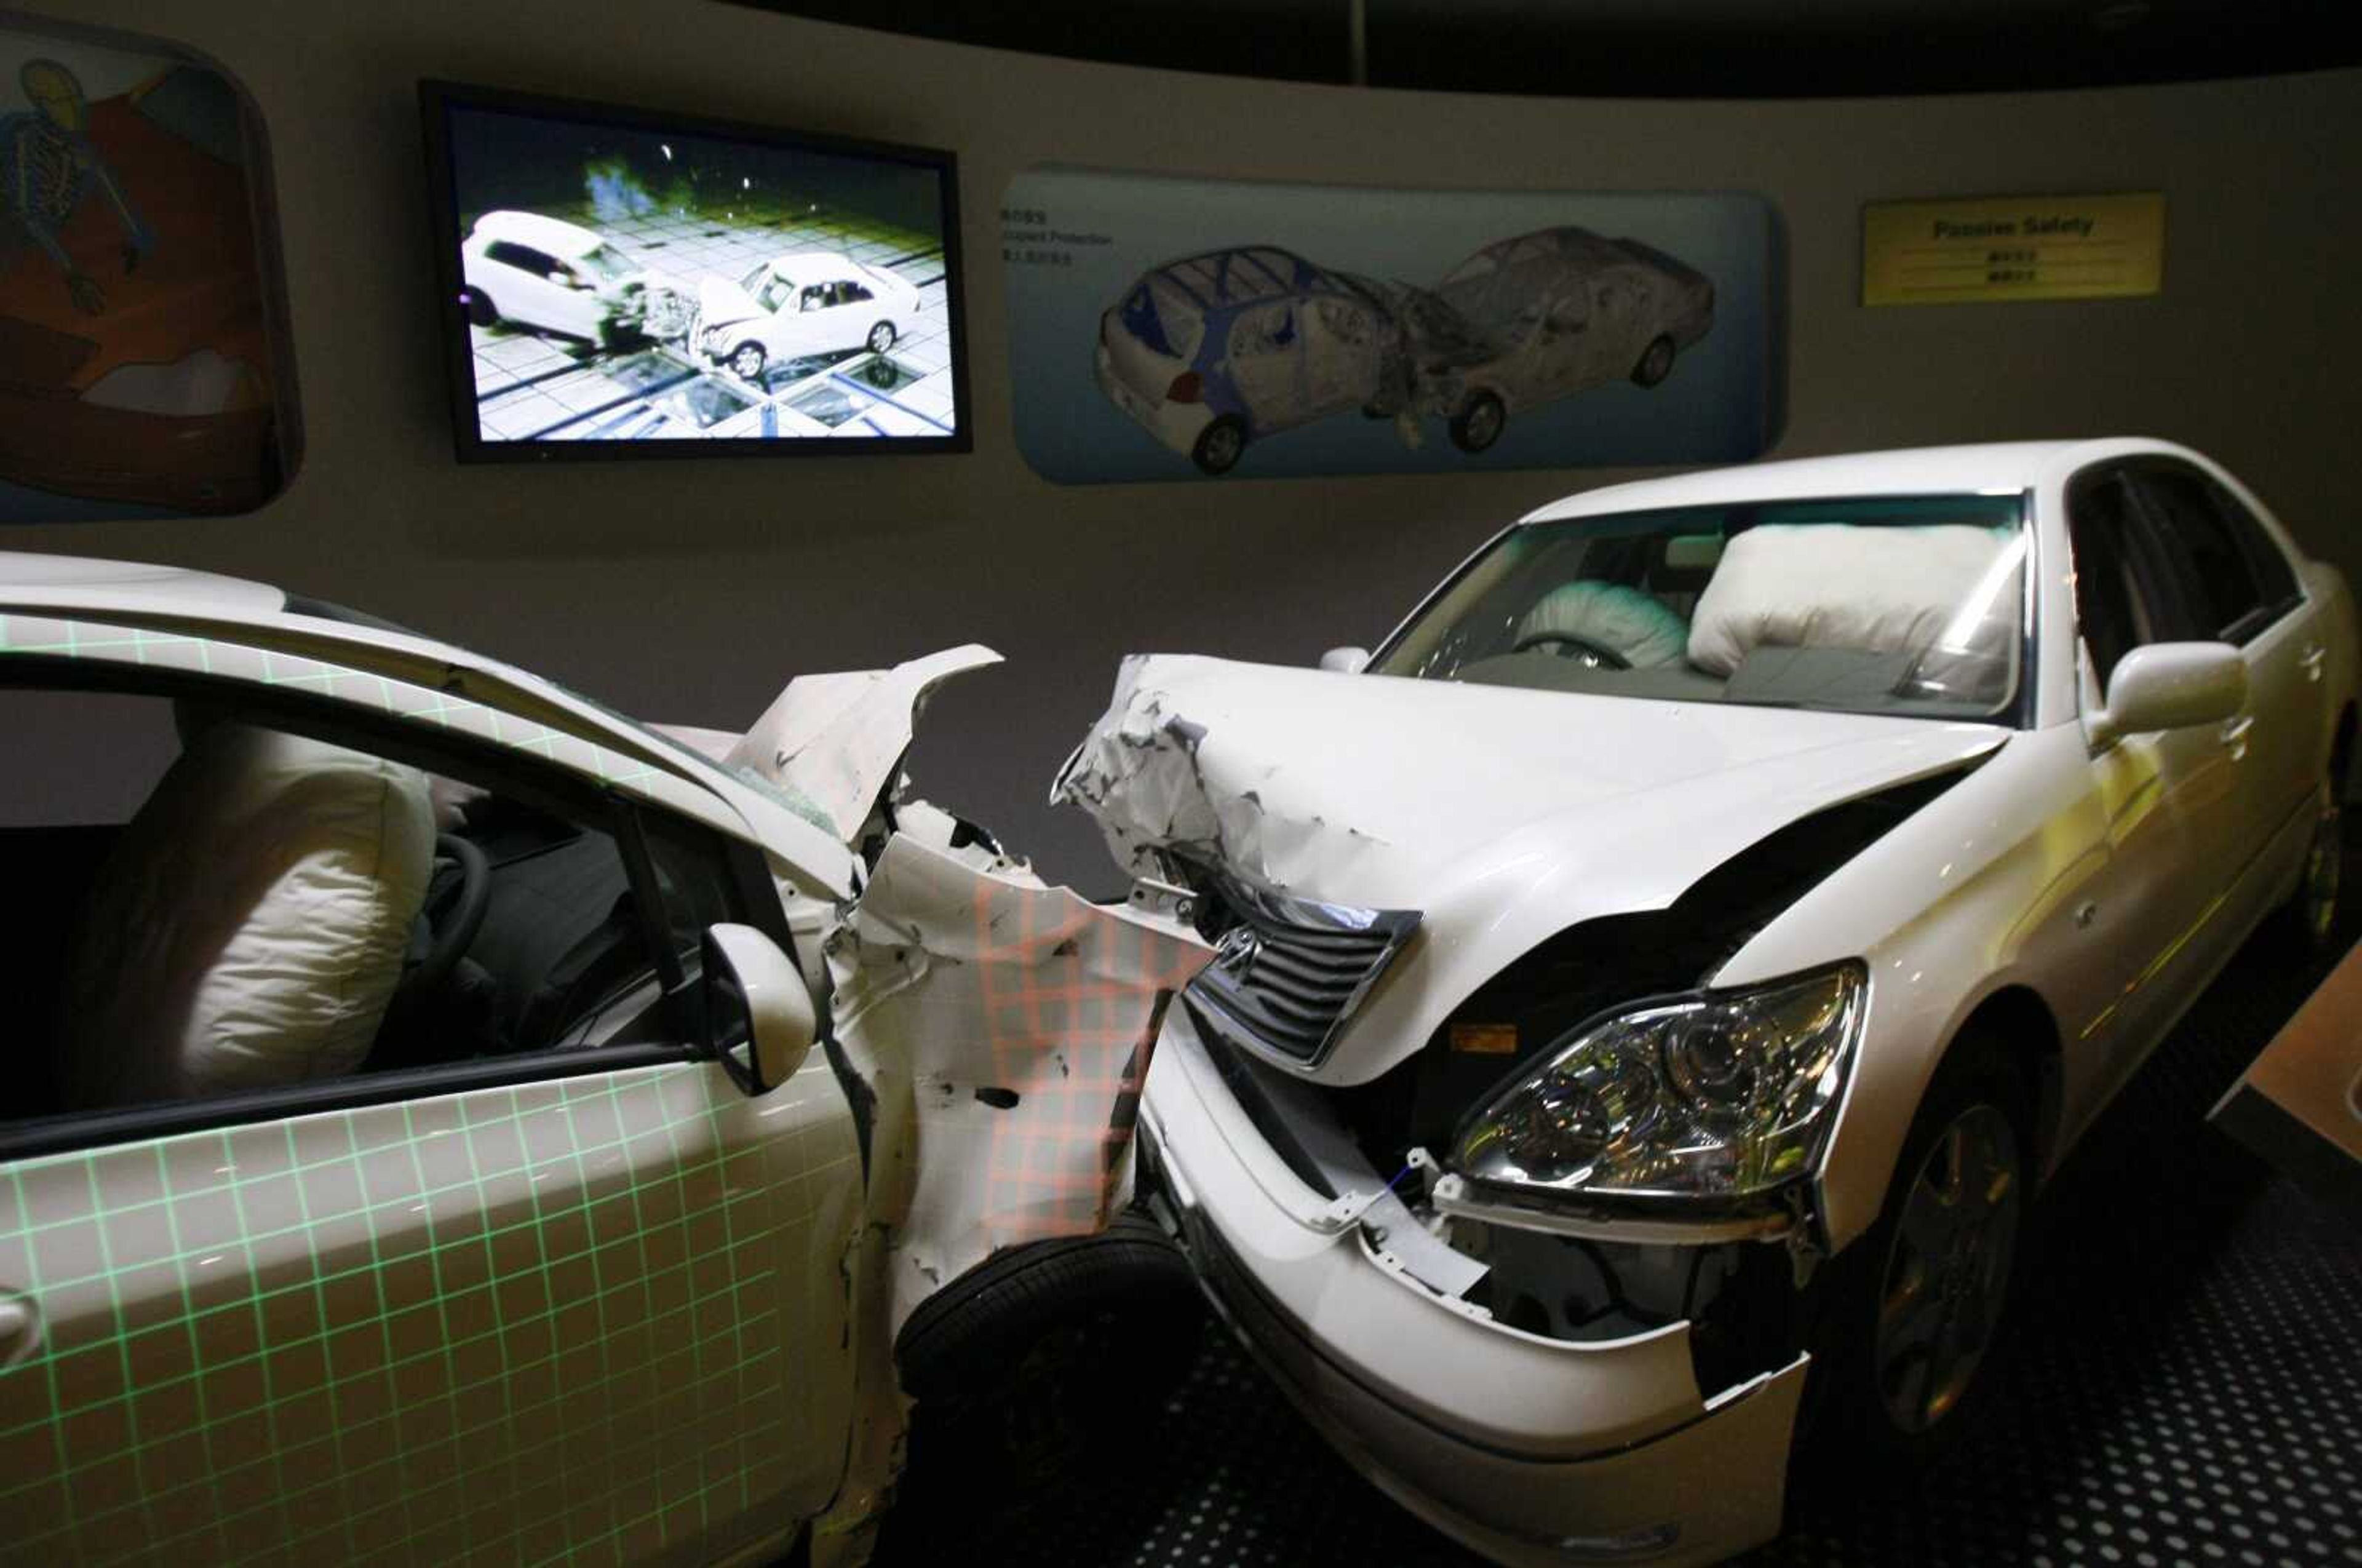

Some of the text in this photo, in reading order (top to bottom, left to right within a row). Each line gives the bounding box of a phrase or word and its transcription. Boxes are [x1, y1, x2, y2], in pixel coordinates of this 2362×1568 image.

[1933, 215, 2094, 238] Passive Safety
[1050, 230, 1113, 245] Protection
